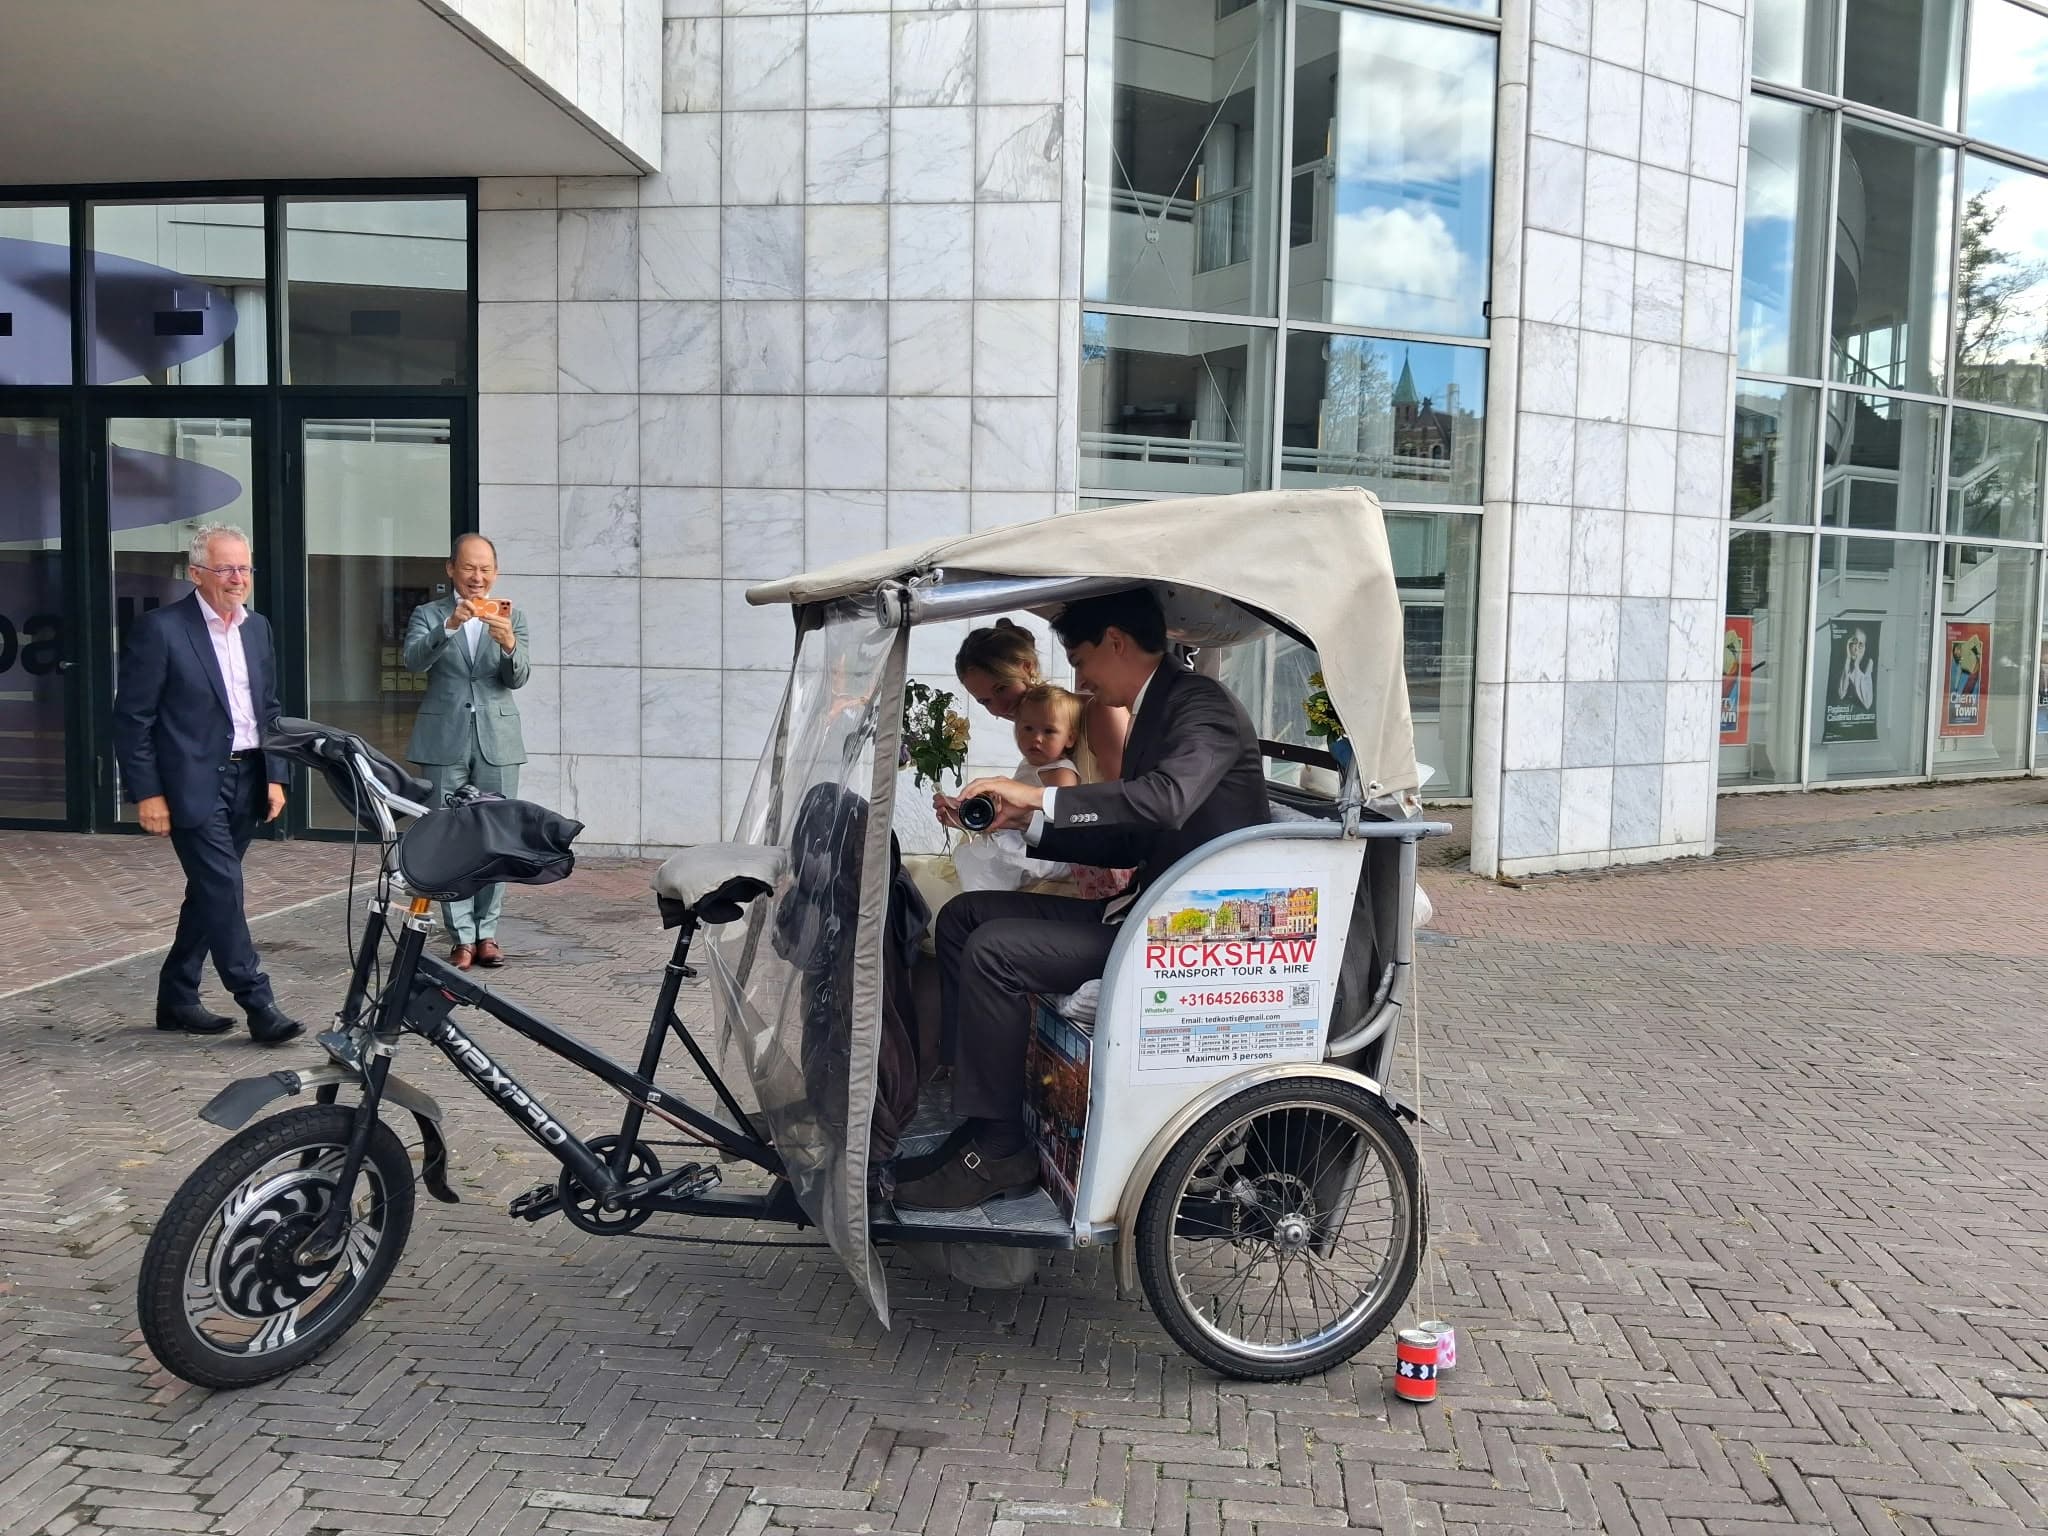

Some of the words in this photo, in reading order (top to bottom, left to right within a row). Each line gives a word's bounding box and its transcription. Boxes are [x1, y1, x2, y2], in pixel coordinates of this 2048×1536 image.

[1950, 691, 1977, 706] Cherry
[1954, 703, 1978, 718] Town
[1146, 940, 1316, 968] RICKSHAW
[1154, 967, 1225, 979] TRANSPORT
[1233, 966, 1263, 976] TOUR
[1269, 965, 1277, 974] &
[1284, 964, 1309, 974] HIRE
[1179, 989, 1284, 1007] +31645266338
[1144, 1006, 1175, 1014] WhatsApp
[1181, 1017, 1204, 1025] Email:
[1186, 1053, 1230, 1063] Maximum
[1232, 1052, 1239, 1061] 3
[1240, 1051, 1273, 1061] persons
